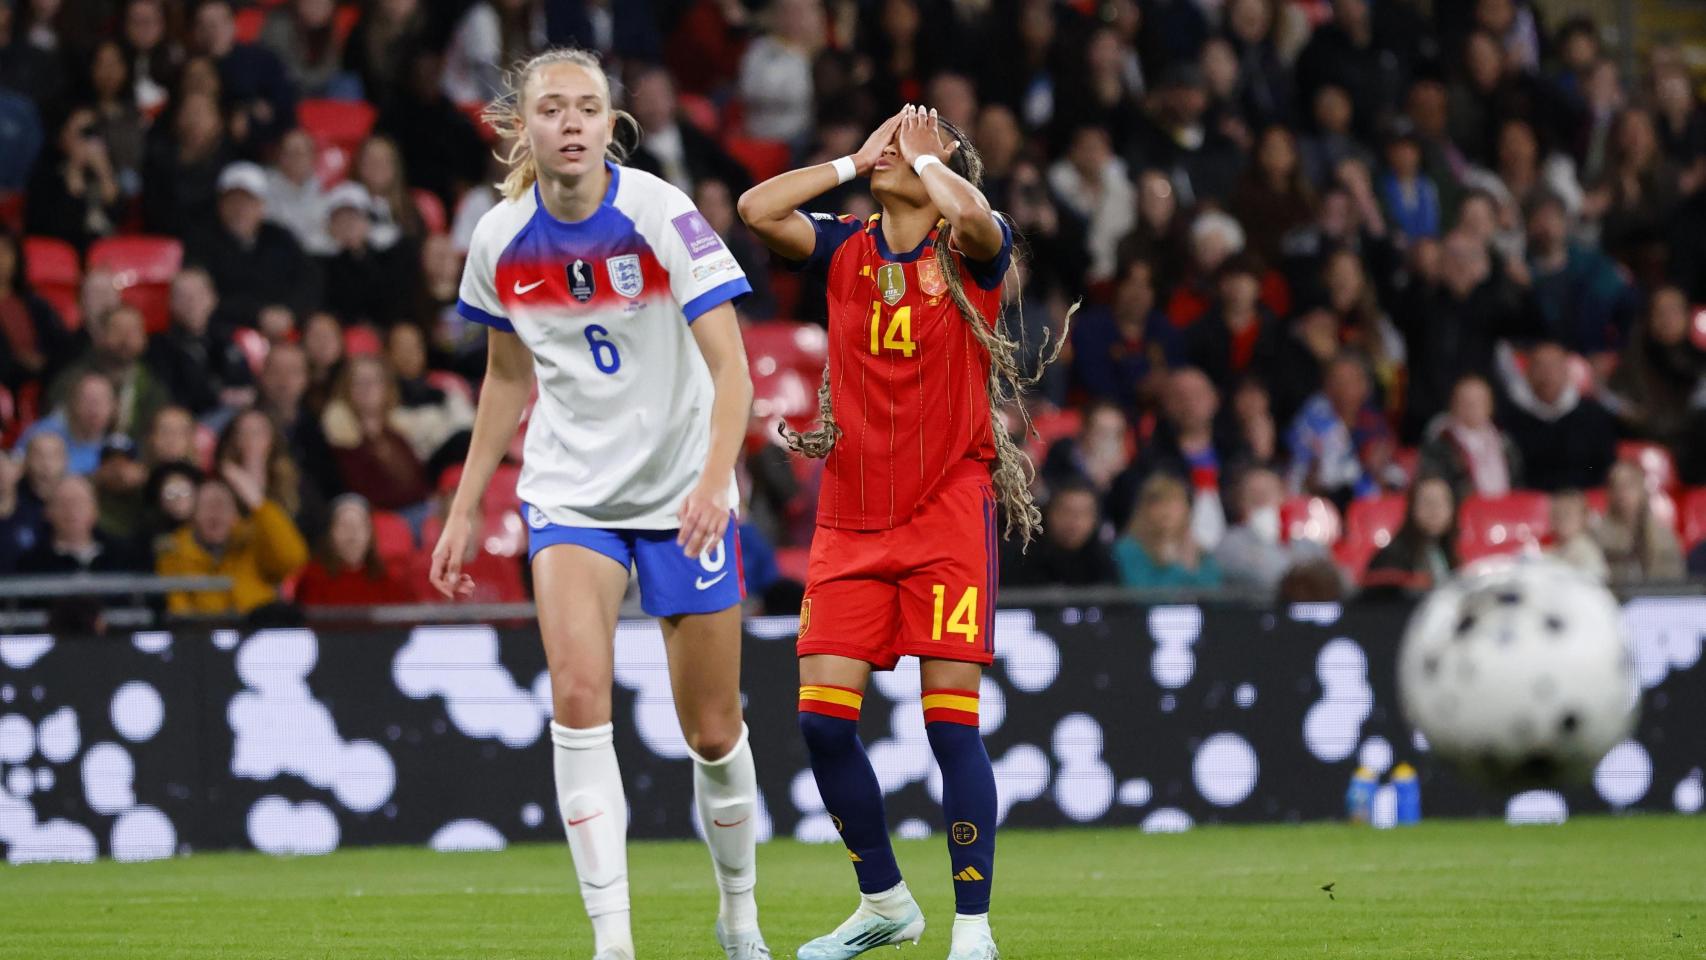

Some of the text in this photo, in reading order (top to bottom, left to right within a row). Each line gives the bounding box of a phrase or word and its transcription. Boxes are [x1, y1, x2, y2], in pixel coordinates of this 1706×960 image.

[584, 324, 621, 374] 6
[870, 300, 916, 357] 14
[931, 584, 979, 643] 14
